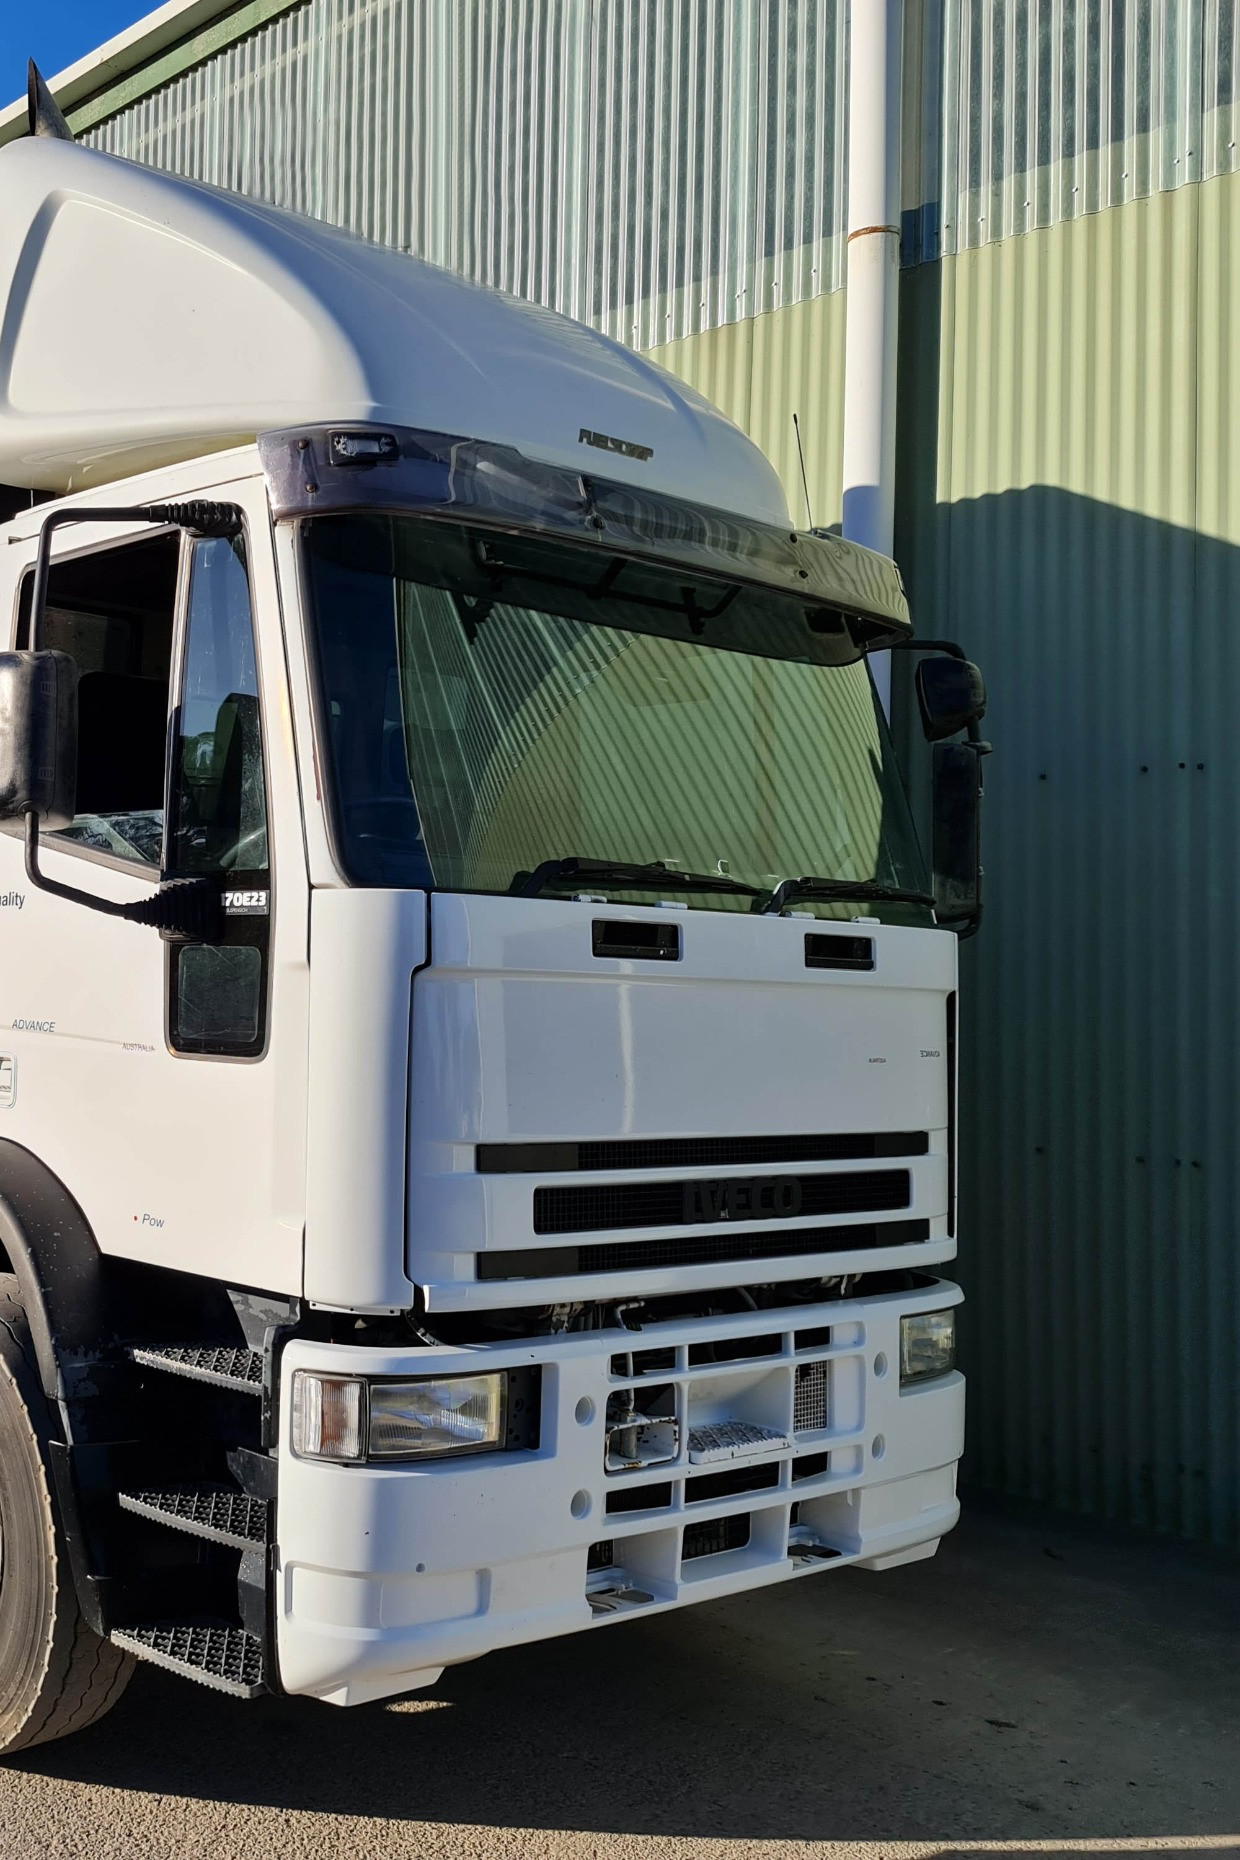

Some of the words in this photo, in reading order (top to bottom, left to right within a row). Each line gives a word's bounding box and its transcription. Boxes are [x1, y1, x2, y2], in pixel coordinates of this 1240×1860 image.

[11, 1018, 56, 1033] ADVANCE
[122, 1042, 156, 1052] AUSTRALIA
[683, 1177, 802, 1224] IVECO
[141, 1213, 165, 1228] Pow
